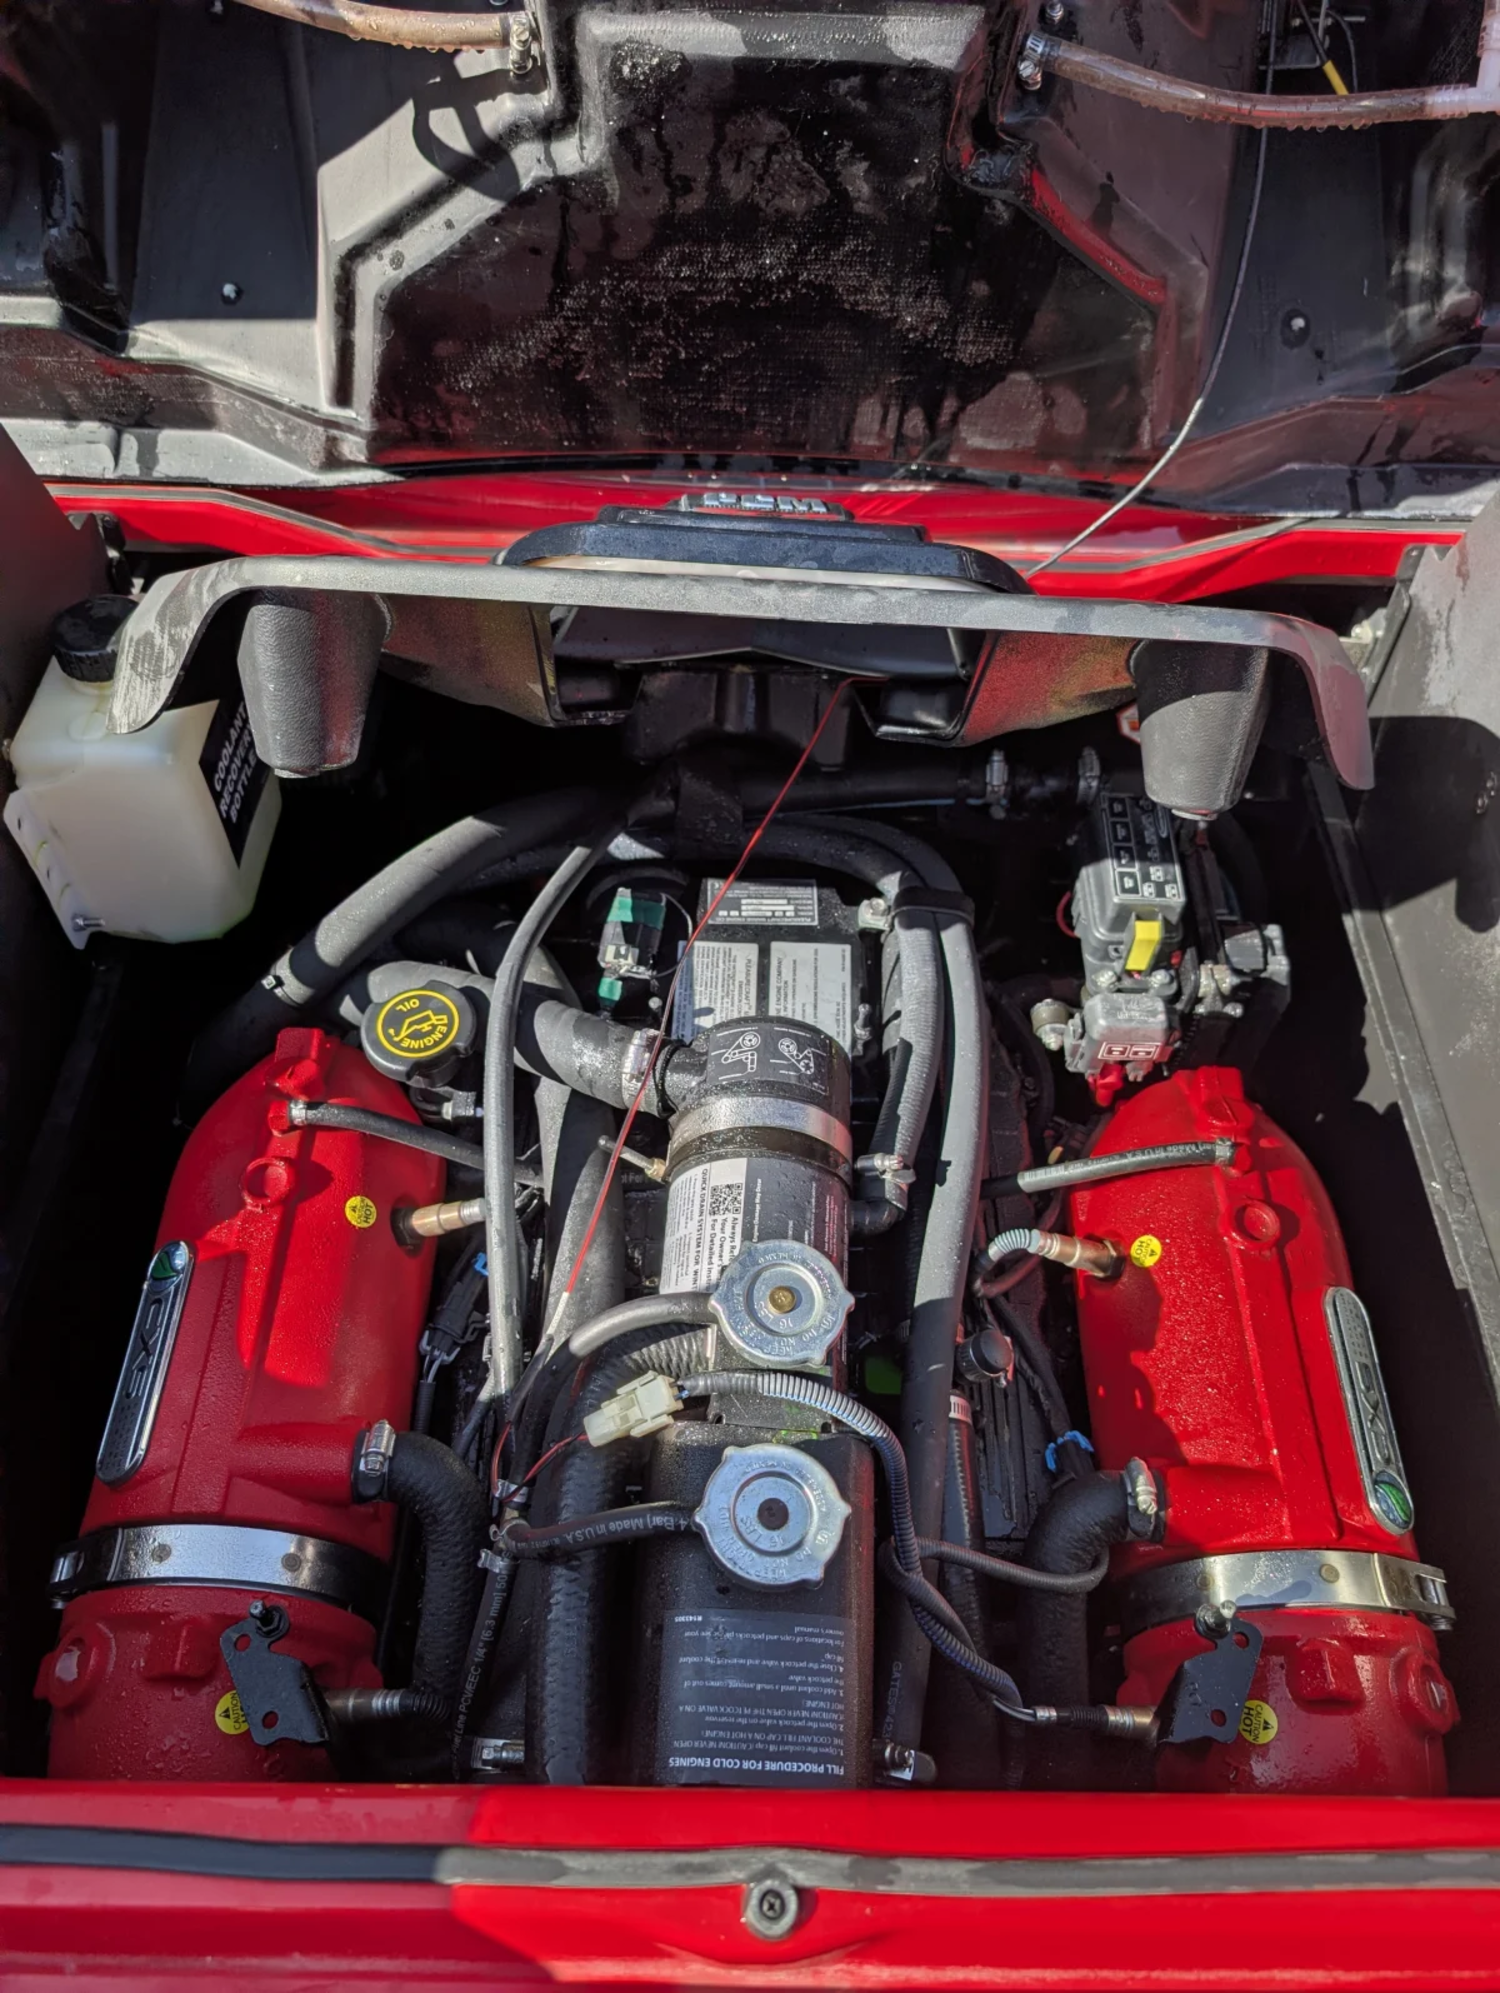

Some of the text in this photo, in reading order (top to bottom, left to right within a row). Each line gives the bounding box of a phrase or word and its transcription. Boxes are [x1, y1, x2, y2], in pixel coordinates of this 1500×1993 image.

[214, 701, 246, 792] COOLANT
[220, 723, 252, 818] RECOVER
[230, 749, 256, 823] BOTTLE
[396, 998, 420, 1013] OIL
[400, 1025, 448, 1049] ENGINE
[700, 1168, 708, 1192] QUICK
[698, 1194, 706, 1217] DRAIN
[363, 1203, 373, 1224] HOT
[710, 1219, 718, 1231] For
[720, 1218, 728, 1234] Your
[729, 1217, 738, 1243] Always
[695, 1219, 704, 1248] SYSTEM
[707, 1233, 716, 1265] Detailed
[595, 1524, 605, 1535] in
[608, 1518, 643, 1535] Made
[563, 1527, 594, 1544] U.S.A.
[487, 1592, 507, 1617] mm]
[479, 1619, 494, 1641] [6.3
[794, 1626, 820, 1634] manual
[735, 1632, 765, 1642] petcocks
[804, 1637, 834, 1647] locations
[473, 1641, 488, 1662] 1/4"
[679, 1656, 703, 1664] coolant
[746, 1659, 760, 1667] and
[761, 1660, 779, 1668] valve
[780, 1660, 807, 1670] petcock
[807, 1662, 819, 1671] the
[788, 1675, 807, 1683] valve
[807, 1675, 834, 1685] petcock
[459, 1665, 482, 1712] PCV/EEC
[798, 1685, 823, 1694] coolant
[824, 1687, 837, 1695] Add
[230, 1693, 241, 1730] CAUTION
[454, 1713, 466, 1733] Line
[735, 1717, 747, 1725] the
[759, 1718, 777, 1726] valve
[778, 1718, 806, 1728] petcock
[806, 1721, 818, 1729] the
[1242, 1706, 1254, 1736] HOT
[1252, 1704, 1263, 1742] CAUTION
[754, 1732, 766, 1740] ON
[766, 1733, 781, 1741] CAP
[798, 1735, 831, 1744] COOLANT
[755, 1741, 768, 1750] cap
[779, 1745, 806, 1753] coolant
[806, 1746, 818, 1754] the
[819, 1745, 837, 1754] Open
[669, 1757, 844, 1775] FILL PROCEDURE FOR COLD ENGINES
